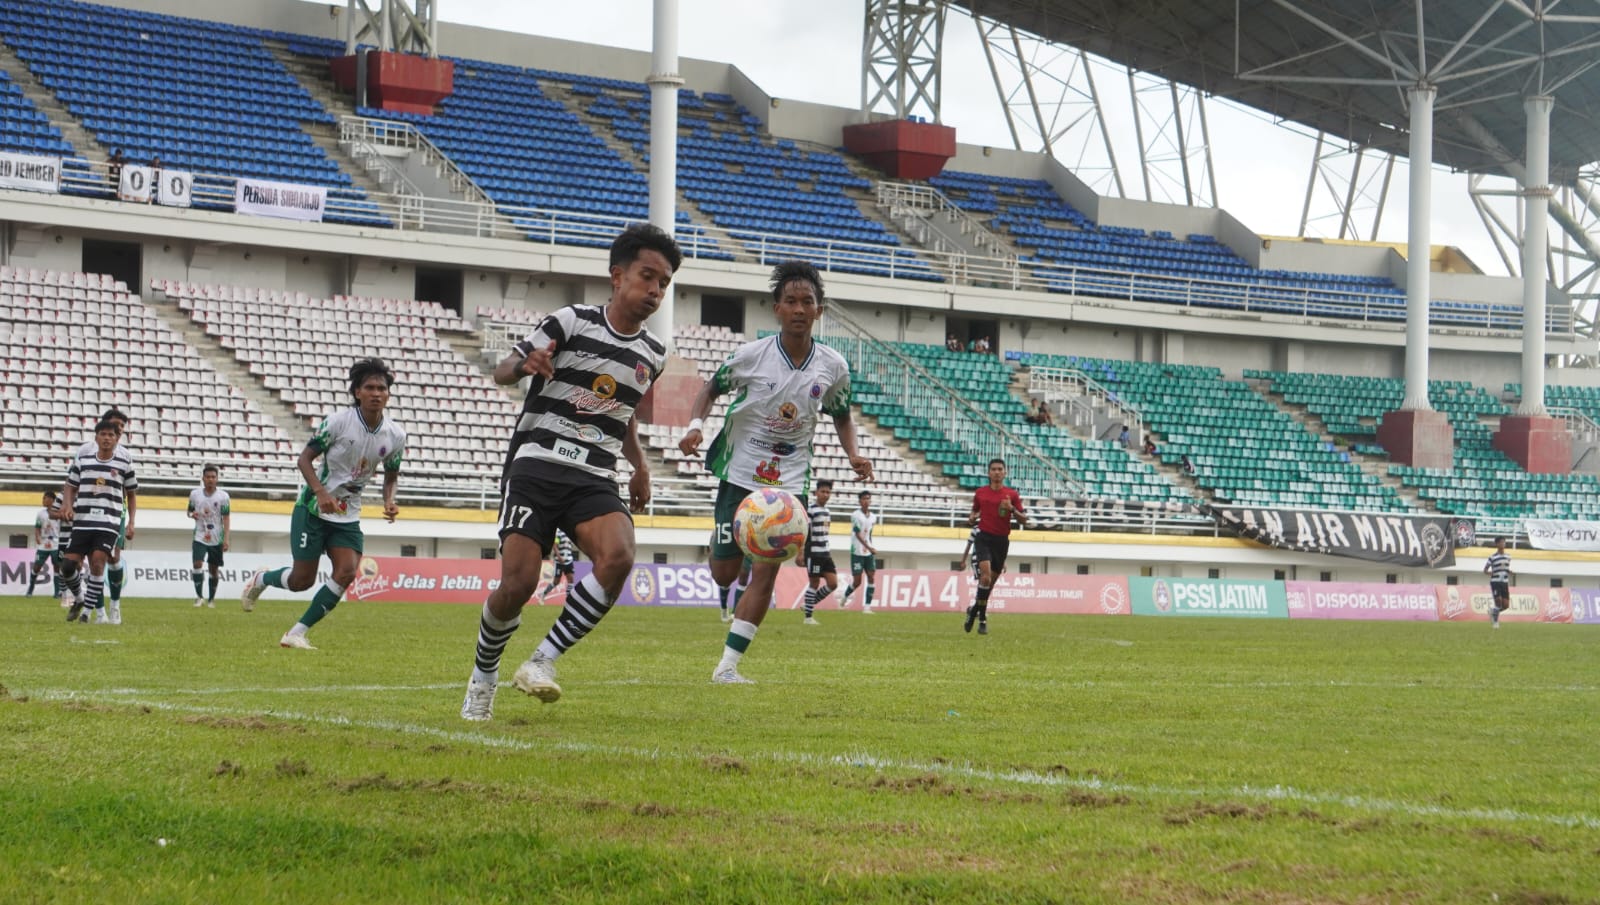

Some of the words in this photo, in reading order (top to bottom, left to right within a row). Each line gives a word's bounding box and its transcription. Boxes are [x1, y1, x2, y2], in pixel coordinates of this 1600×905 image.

[14, 161, 55, 182] JEMBER
[130, 171, 144, 191] 0
[171, 177, 184, 196] 0
[243, 185, 279, 206] PERSIDA
[280, 189, 320, 210] SIDOARJO
[558, 447, 578, 460] BIG
[506, 505, 533, 529] 17
[299, 532, 307, 548] 3
[716, 522, 732, 544] 15
[1296, 512, 1350, 548] AIR
[1350, 514, 1422, 557] MATA
[1567, 529, 1598, 542] KJTV
[392, 573, 436, 590] Jelas
[440, 575, 482, 590] lebih
[657, 567, 719, 599] PSSI
[863, 574, 932, 608] LIGA
[940, 575, 959, 608] 4
[1014, 577, 1034, 587] API
[992, 589, 1035, 599] GUBERNUR
[1036, 590, 1058, 599] JAWA
[1059, 590, 1084, 600] TIMUR
[1173, 583, 1218, 609] PSSI
[1219, 583, 1268, 609] JATIM
[1315, 592, 1379, 609] DISPORA
[1381, 594, 1437, 610] JEMBER
